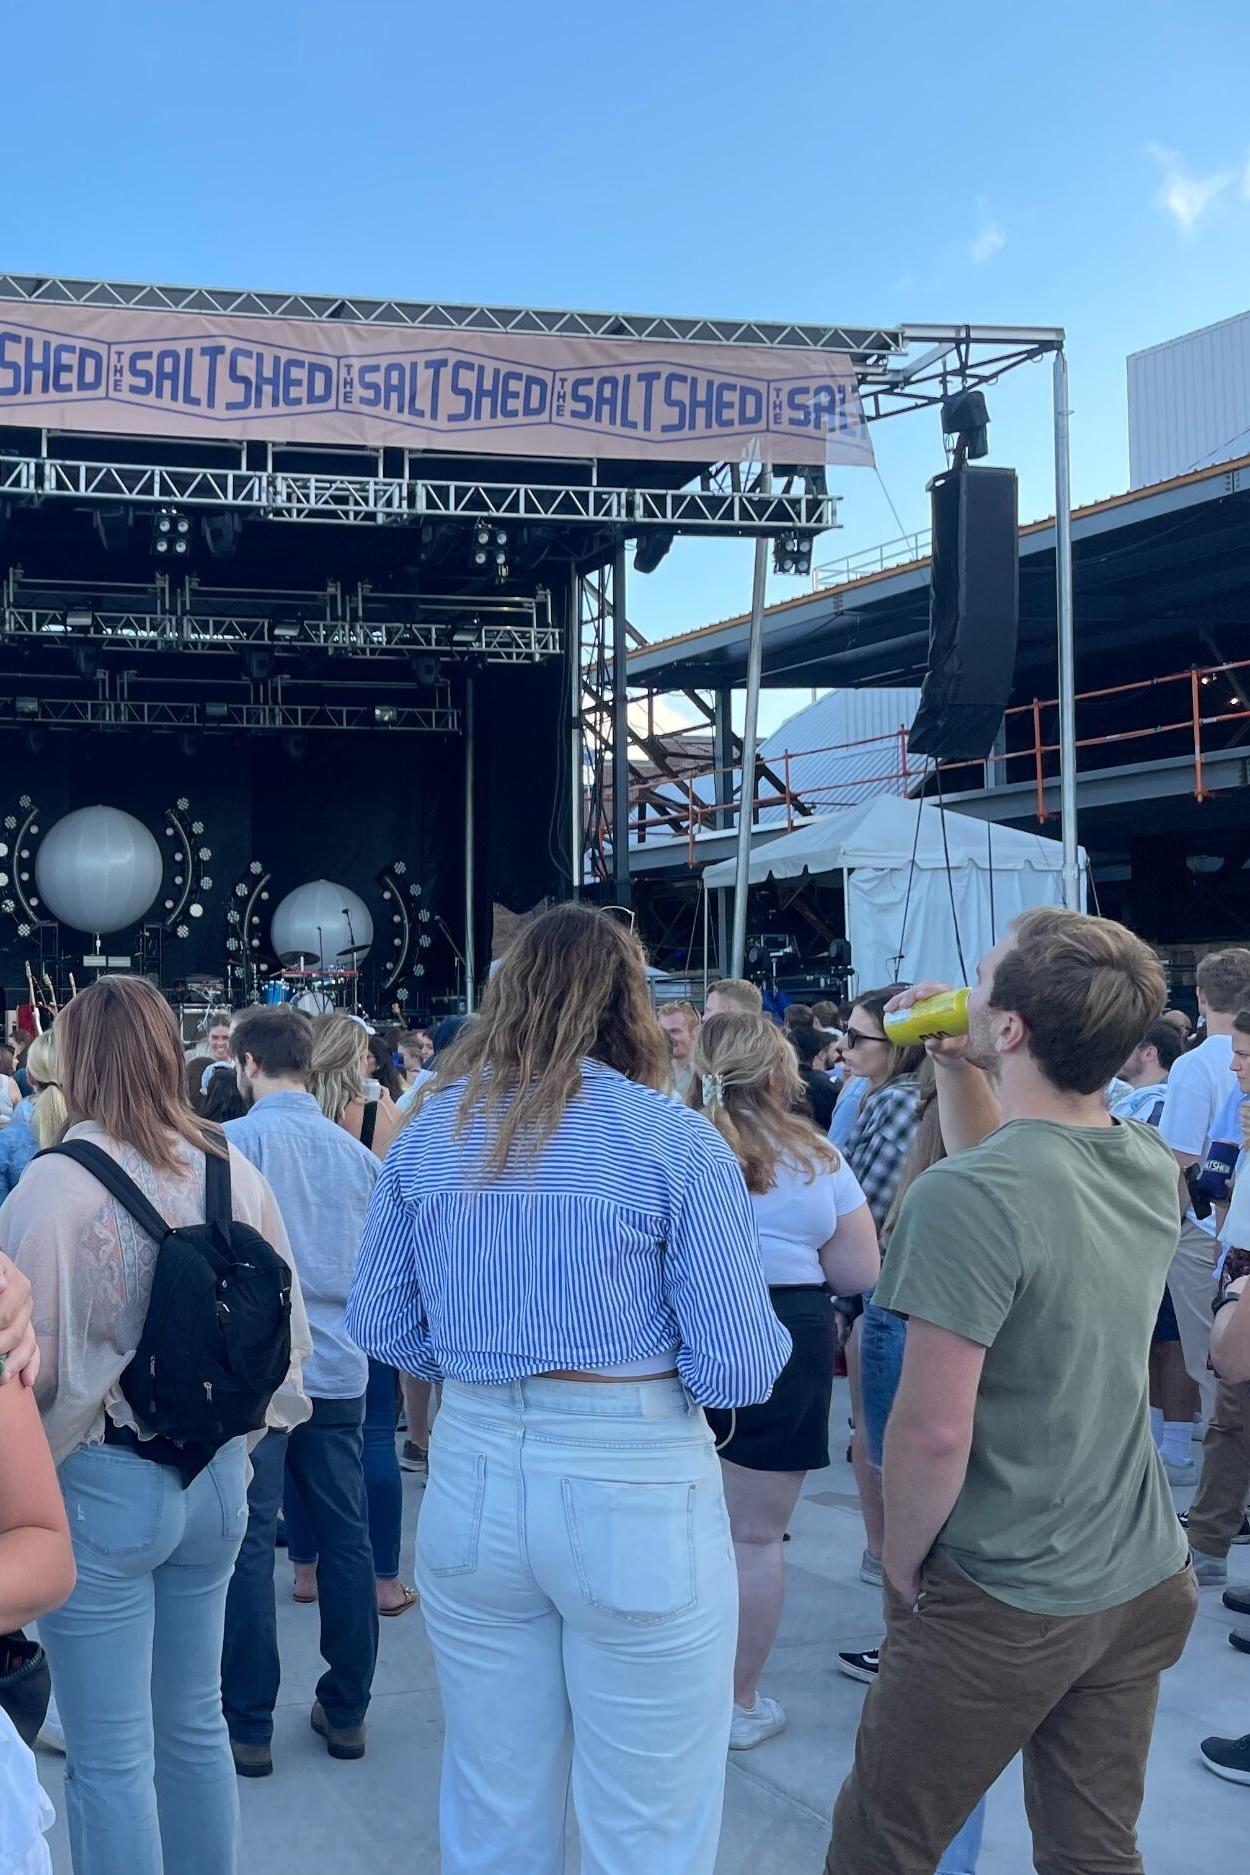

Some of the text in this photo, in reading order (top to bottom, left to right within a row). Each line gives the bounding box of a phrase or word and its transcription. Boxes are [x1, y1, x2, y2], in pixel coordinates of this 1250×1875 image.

[113, 350, 125, 393] THE
[343, 363, 354, 405] THE
[558, 377, 569, 418] THE
[773, 387, 783, 425] THE
